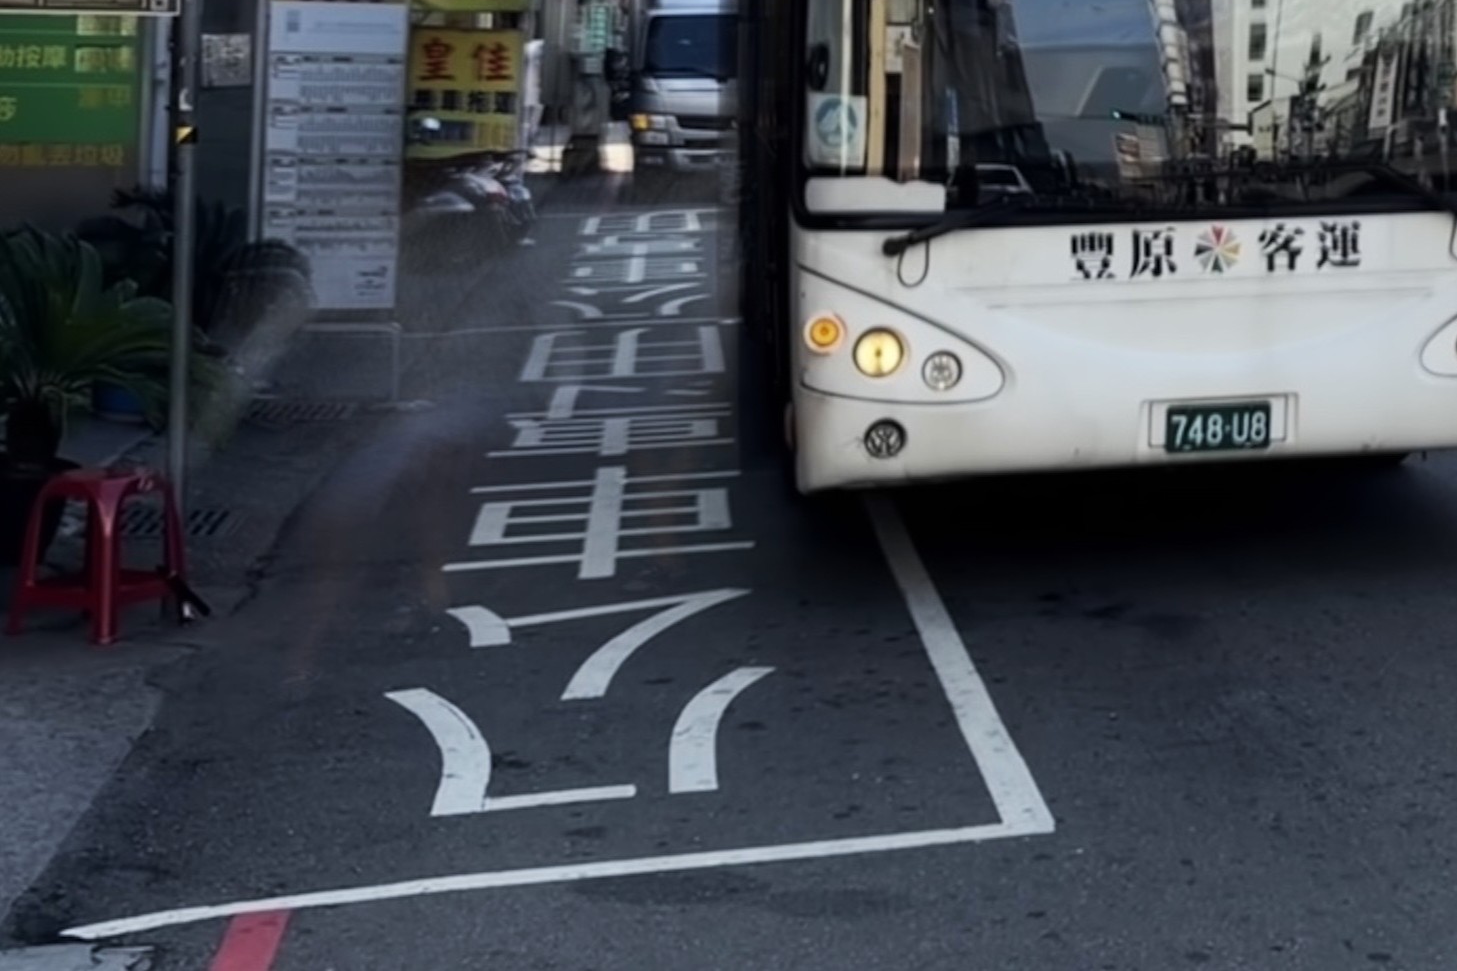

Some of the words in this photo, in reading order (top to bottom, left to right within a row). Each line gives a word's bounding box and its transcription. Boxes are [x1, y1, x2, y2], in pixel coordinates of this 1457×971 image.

[1070, 226, 1178, 280] 豐原
[1258, 221, 1362, 274] 客運
[1171, 411, 1268, 448] 748-U8
